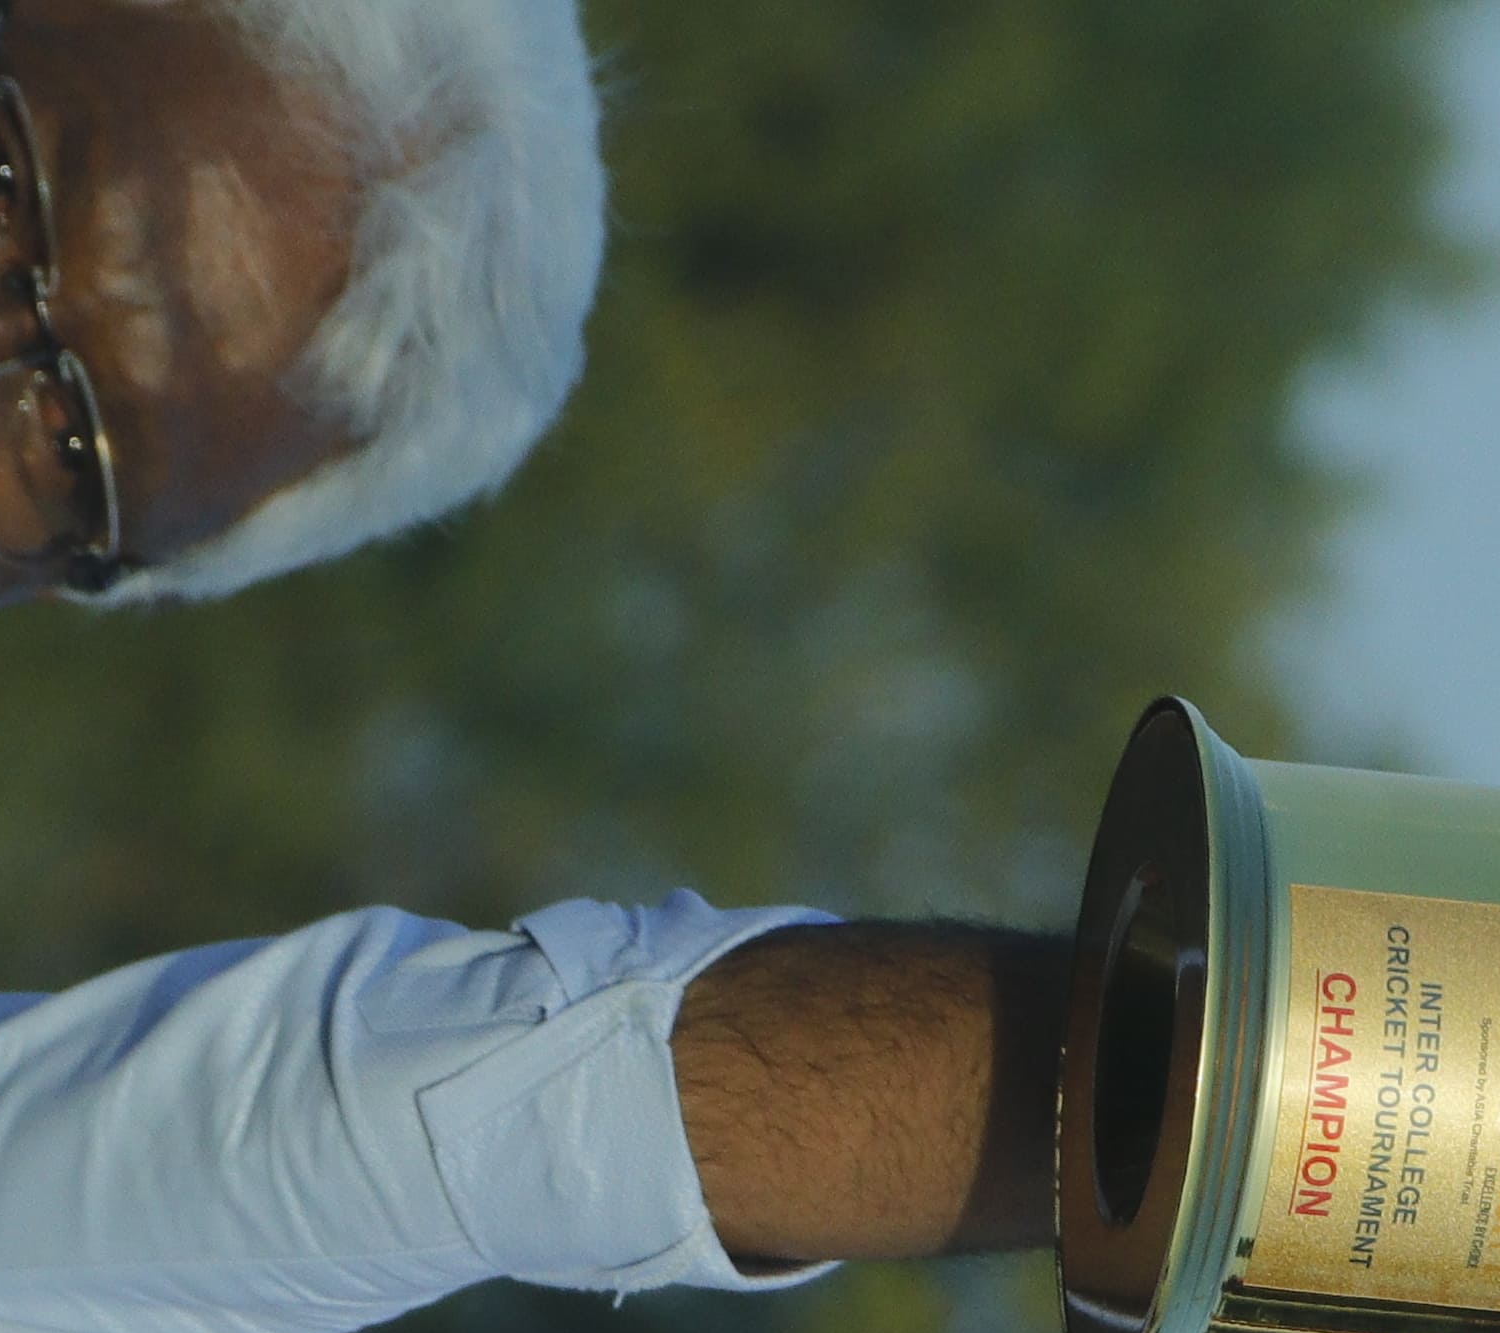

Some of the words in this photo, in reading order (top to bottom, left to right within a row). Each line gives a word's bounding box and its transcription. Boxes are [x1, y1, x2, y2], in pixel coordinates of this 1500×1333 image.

[1384, 925, 1410, 1056] CRICKET
[1415, 982, 1443, 1073] INTER
[1476, 1017, 1492, 1076] Sponsored
[1295, 972, 1357, 1218] CHAMPION
[1472, 1093, 1486, 1122] ASIA
[1474, 1077, 1487, 1092] by
[1349, 1068, 1404, 1269] TOURNAMENT
[1392, 1084, 1436, 1226] COLLEGE
[1473, 1226, 1487, 1239] BY
[1474, 1166, 1498, 1225] EXCELLENCE
